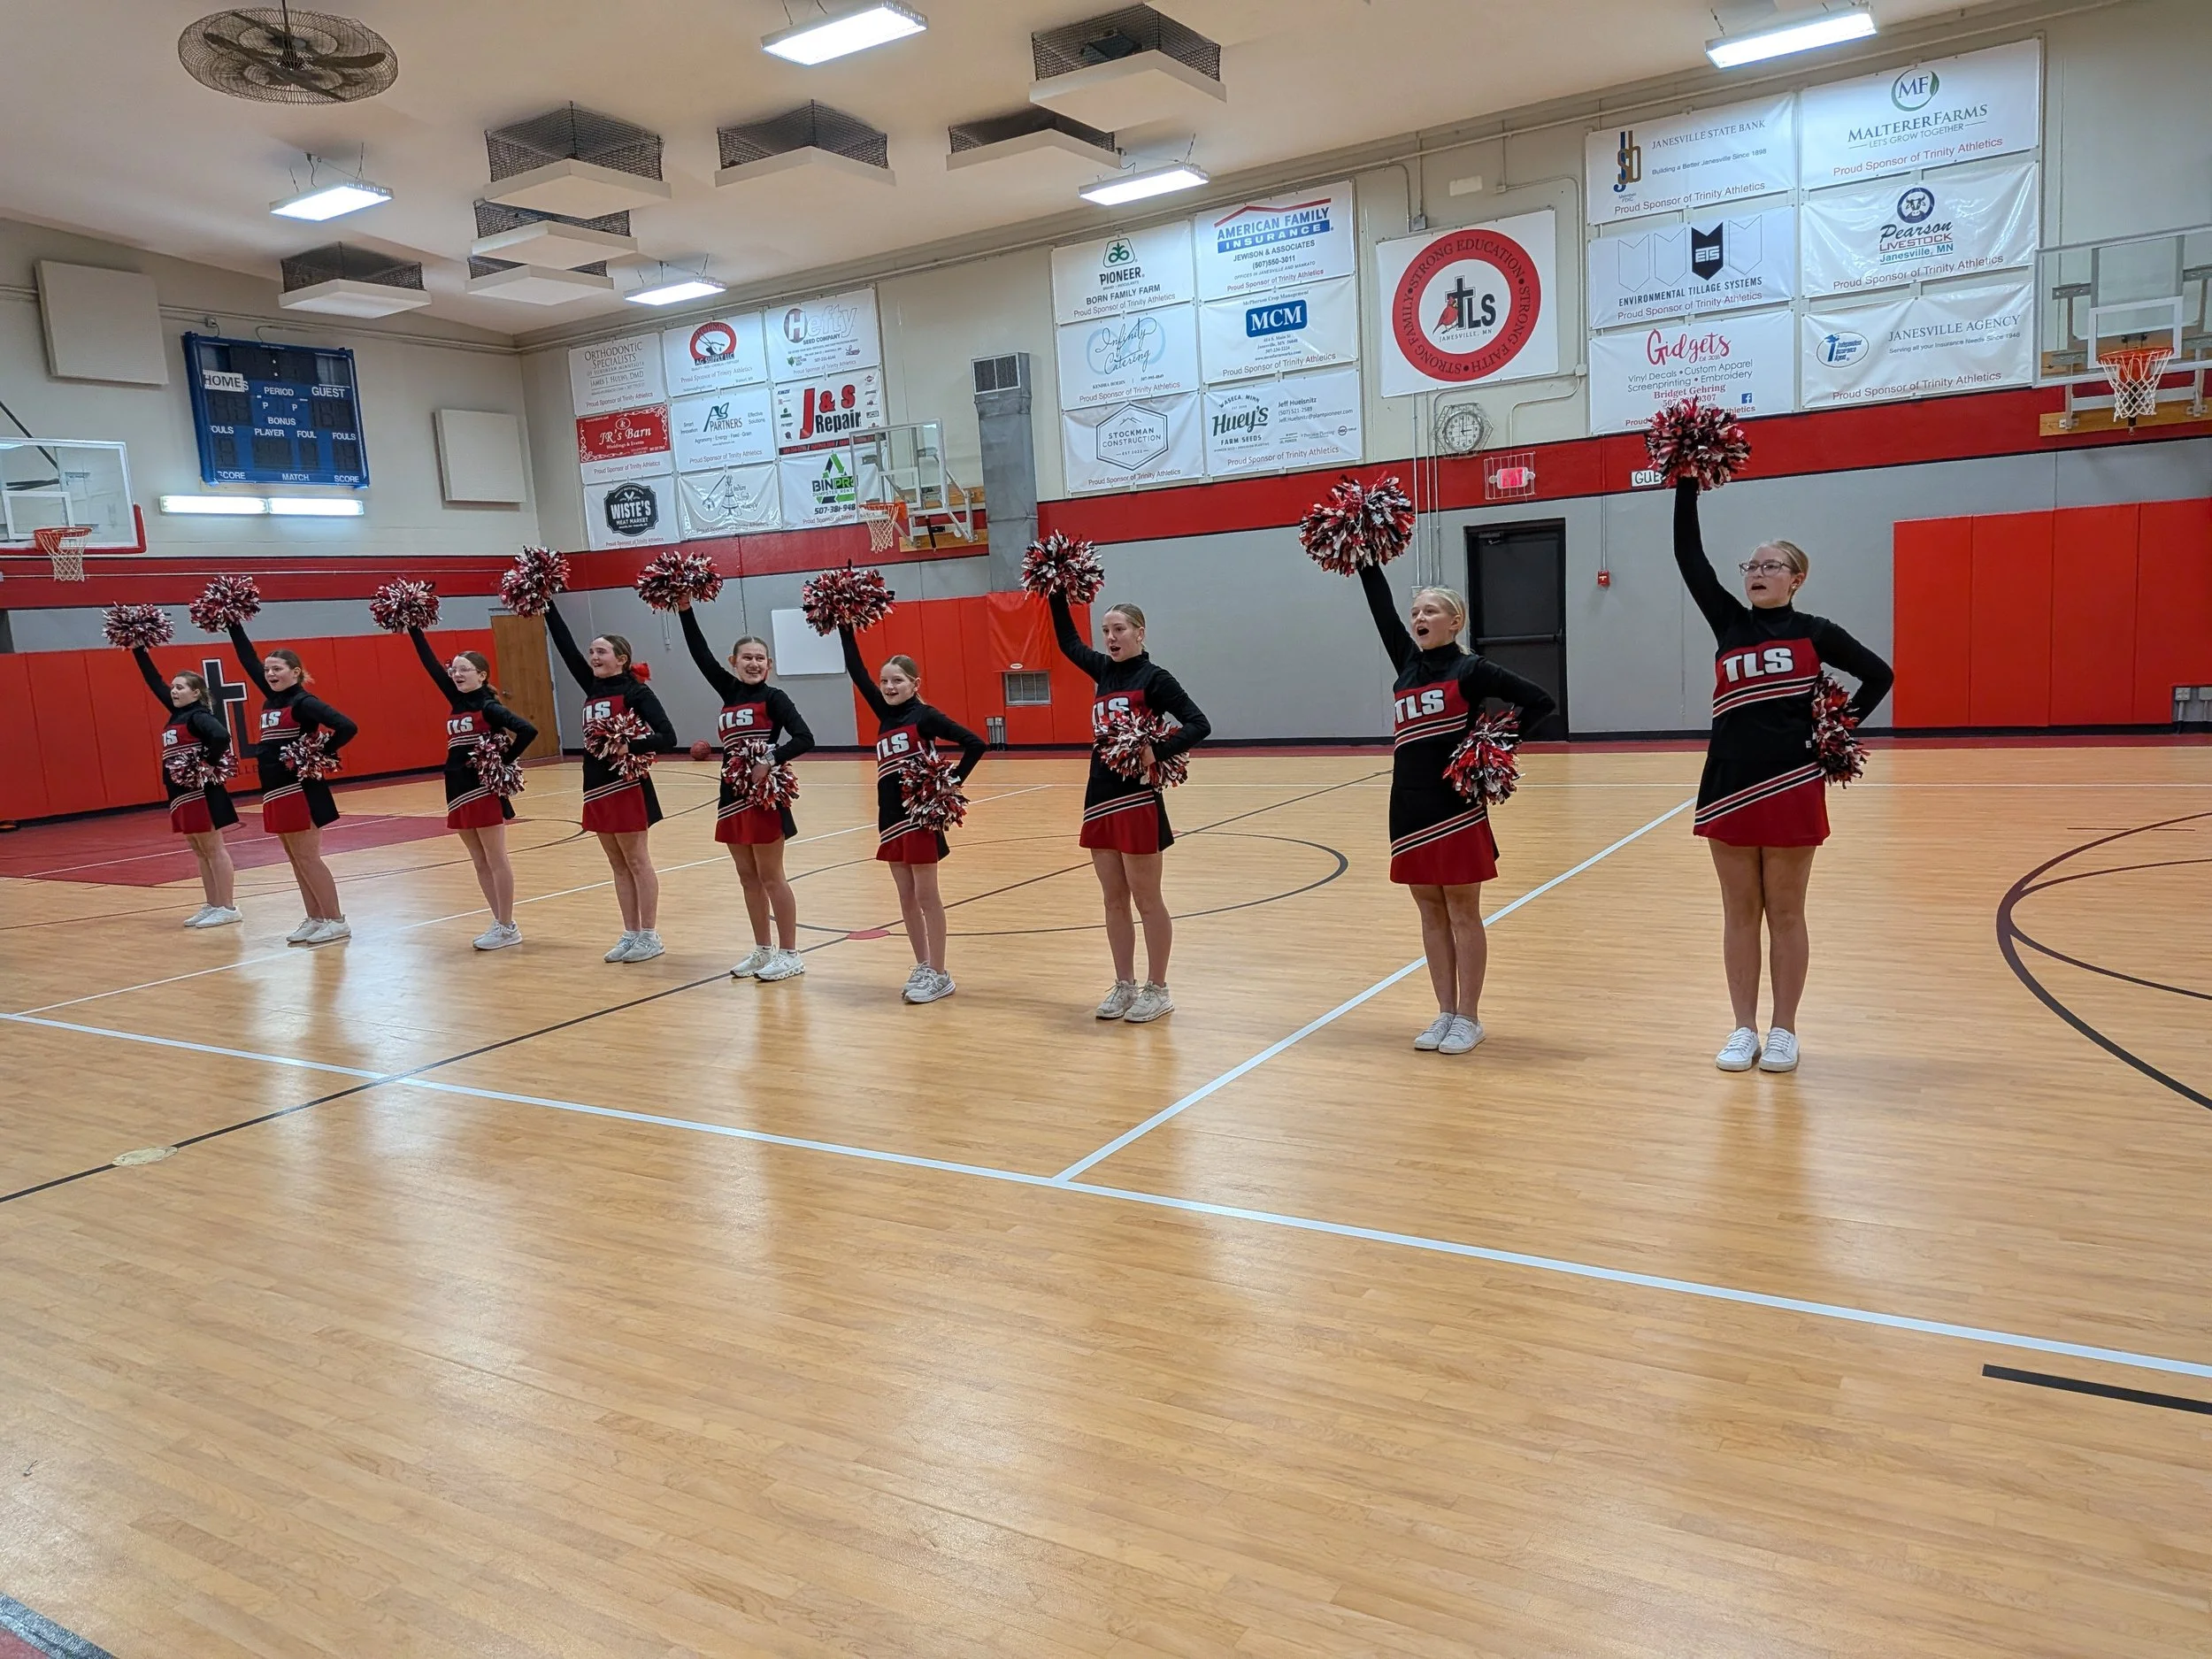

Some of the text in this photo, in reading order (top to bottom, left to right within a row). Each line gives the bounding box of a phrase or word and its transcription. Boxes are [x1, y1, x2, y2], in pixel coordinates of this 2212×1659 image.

[1898, 76, 1929, 99] MF
[1651, 119, 1766, 150] JANESVILLE STATE BANK
[1869, 123, 1964, 149] LET'S GROW TOGETHER
[1651, 165, 1676, 175] Building
[1682, 160, 1700, 170] Better
[1701, 155, 1731, 166] Janesville
[1732, 151, 1750, 160] Since
[1751, 148, 1767, 157] 1898
[1833, 137, 2003, 176] Proud Sponsor of Trinity Athletics
[1614, 181, 1765, 215] Proud Sponsor of Trinity Athletics
[1217, 206, 1330, 241] AMERICAN FAMILY
[1879, 221, 1954, 243] Pearson
[1225, 223, 1322, 250] INSURANCE
[1879, 233, 1953, 251] LIVESTOCK
[1233, 250, 1264, 262] JEWISON
[1271, 240, 1316, 255] ASSOCIATES
[1694, 246, 1720, 263] ETS
[1879, 243, 1954, 263] Janesville, MN
[1409, 238, 1525, 288] STRONG EDUCATION
[1833, 254, 2004, 290] Proud Sponsor of Trinity Athletics
[1099, 266, 1141, 285] PIONEER
[1086, 293, 1108, 305] BORN
[1110, 288, 1137, 301] FAMILY
[1139, 283, 1161, 296] FARM
[1618, 277, 1763, 307] ENVIRONMENTAL TILLAGE SYSTEMS
[1617, 291, 1763, 320] Proud Sponsor of Trinity Athletics
[788, 304, 857, 341] Hefty
[1251, 304, 1302, 332] MCM
[1471, 285, 1531, 373] STRONG FAITH
[1887, 314, 2022, 342] JANESVILLE AGENCY
[816, 333, 841, 342] COMPANY
[1094, 317, 1157, 356] Infinity
[1402, 295, 1463, 373] STRONG FAMILY
[1439, 331, 1479, 342] JANESVILLE,
[1889, 346, 1912, 355] Serving
[1934, 339, 1964, 349] Insurance
[1964, 336, 1985, 345] Needs
[1985, 334, 2004, 342] Since
[1647, 328, 1731, 365] Gidgets
[592, 352, 637, 370] SPECIALISTS
[704, 355, 724, 364] SUPPLY
[1104, 348, 1151, 375] Catering
[1222, 367, 1243, 377] Proud
[1244, 362, 1272, 374] Sponsor
[1274, 359, 1282, 369] of
[1282, 356, 1304, 368] Trinity
[1305, 353, 1336, 364] Athletics
[1628, 358, 1753, 383] Vinyl Decals Custom Apparel
[204, 374, 242, 388] HOME
[264, 386, 345, 398] PERIOD GUEST
[1627, 370, 1753, 393] Screenprinting Embroidery
[1654, 383, 1726, 400] Bridget Gehring
[1832, 372, 2001, 401] Proud Sponsor of Trinity Athletics
[799, 384, 856, 440] J & S
[1289, 397, 1317, 406] Huelsnitz
[267, 416, 296, 426] BONUS
[710, 418, 743, 432] PARTNERS
[815, 409, 861, 434] Repair
[1211, 405, 1269, 437] Huey's
[1625, 405, 1756, 426] Proud thletics
[254, 427, 285, 438] PLAYER
[296, 430, 317, 439] FOUL
[332, 431, 357, 442] FOULS
[598, 427, 652, 446] JR's Barn
[1102, 434, 1162, 448] CONSTRUCTION
[1108, 426, 1155, 440] STOCKMAN
[1220, 434, 1262, 446] FARM SEEDS
[1227, 446, 1340, 466] Proud Sponsor of Trinity Athletics
[281, 473, 310, 482] MATCH
[334, 474, 360, 483] SCORE
[1634, 471, 1661, 485] GUE
[611, 500, 651, 520] WISTE'S
[1723, 647, 1794, 683] TLS
[1395, 688, 1446, 725] TLS
